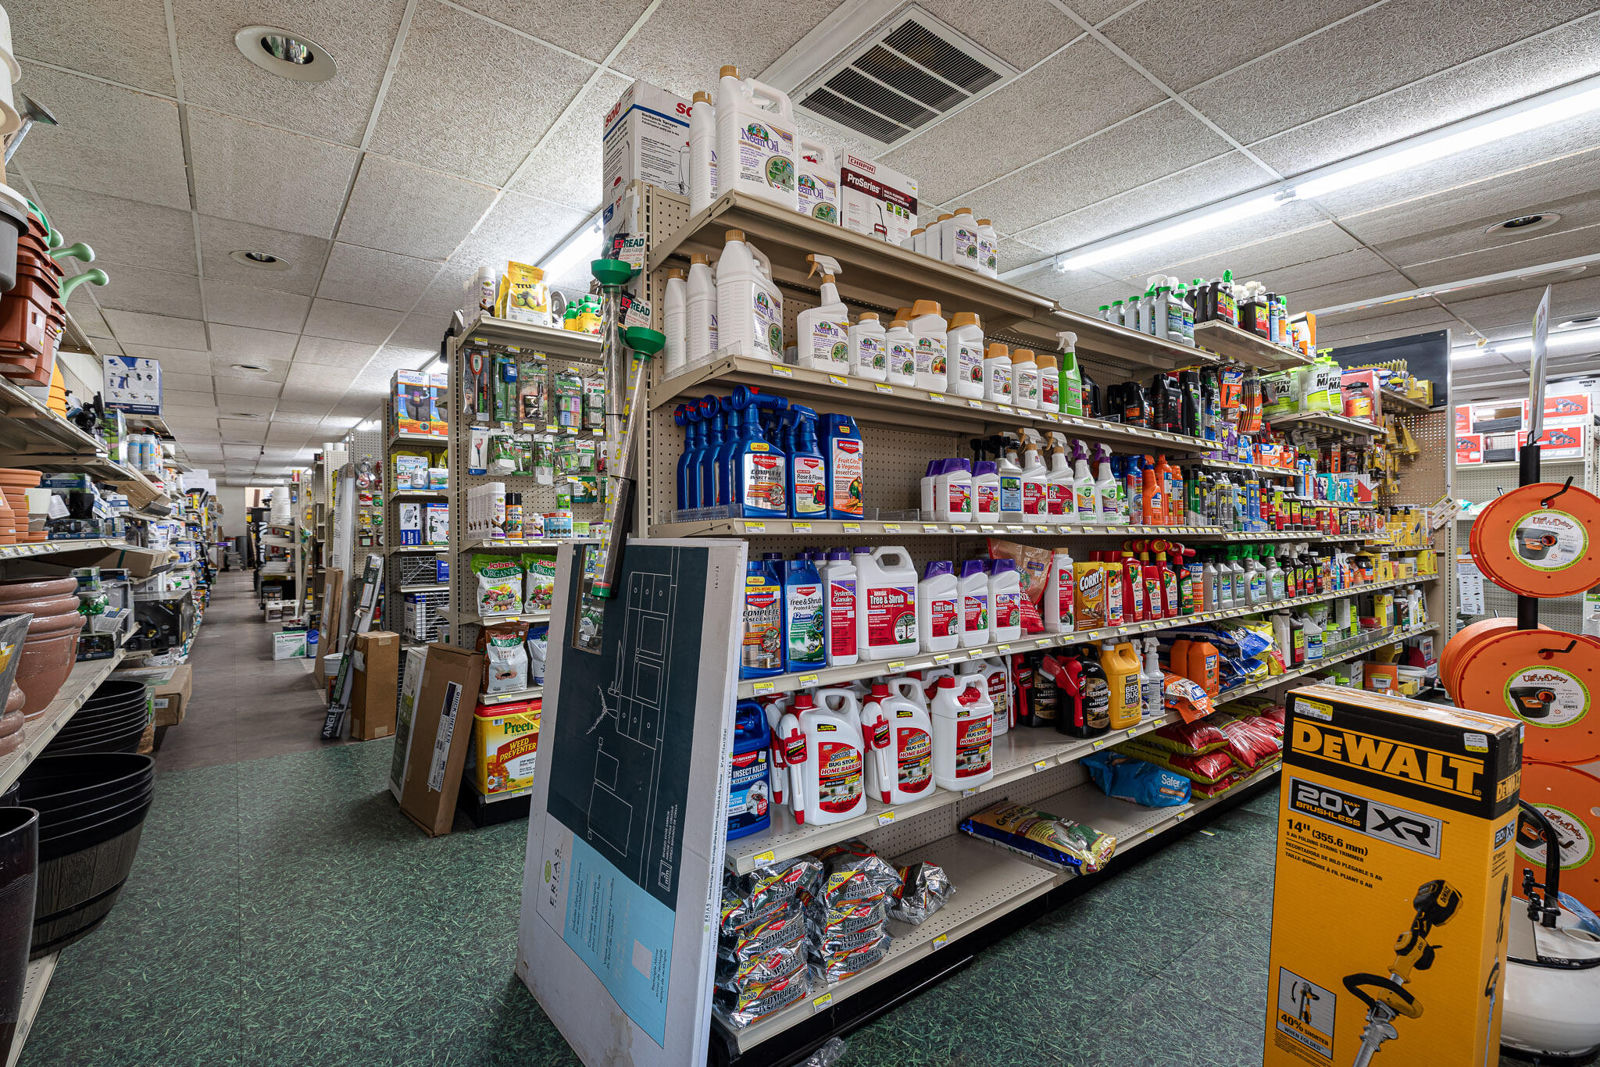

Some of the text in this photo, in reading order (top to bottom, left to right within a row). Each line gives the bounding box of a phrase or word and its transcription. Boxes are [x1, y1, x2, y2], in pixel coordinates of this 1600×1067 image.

[740, 128, 779, 152] Neem Oil
[798, 184, 824, 200] eem Oil
[848, 173, 880, 194] ProSeries
[814, 324, 838, 336] Neem Oil
[631, 360, 638, 371] 5
[614, 448, 622, 460] 3
[870, 596, 883, 604] Tree
[889, 594, 904, 603] Shrub
[452, 692, 460, 713] QUICK
[1126, 691, 1138, 699] BUG
[446, 714, 456, 744] SHELTER
[504, 722, 533, 734] Preen
[500, 742, 536, 762] PREVENTER
[510, 738, 529, 750] WEED
[841, 762, 862, 771] BARRIER
[1292, 720, 1484, 795] DEWALT
[733, 763, 768, 778] INSECT KILLER
[1296, 801, 1361, 827] BRUSHLESS
[1371, 808, 1431, 848] XR
[1287, 819, 1368, 856] 14" (355.6 mm)
[1298, 836, 1319, 846] FOLDING
[1320, 843, 1338, 853] STRING
[1339, 850, 1364, 862] TRIMMER
[1329, 857, 1340, 865] HILO
[1342, 862, 1368, 875] PLEGABLE
[1341, 873, 1359, 883] PLIANT
[761, 922, 798, 946] COMPLETE
[761, 985, 800, 1006] COMPLETE
[1281, 1014, 1303, 1032] 40%
[1305, 1029, 1328, 1046] SHORTER
